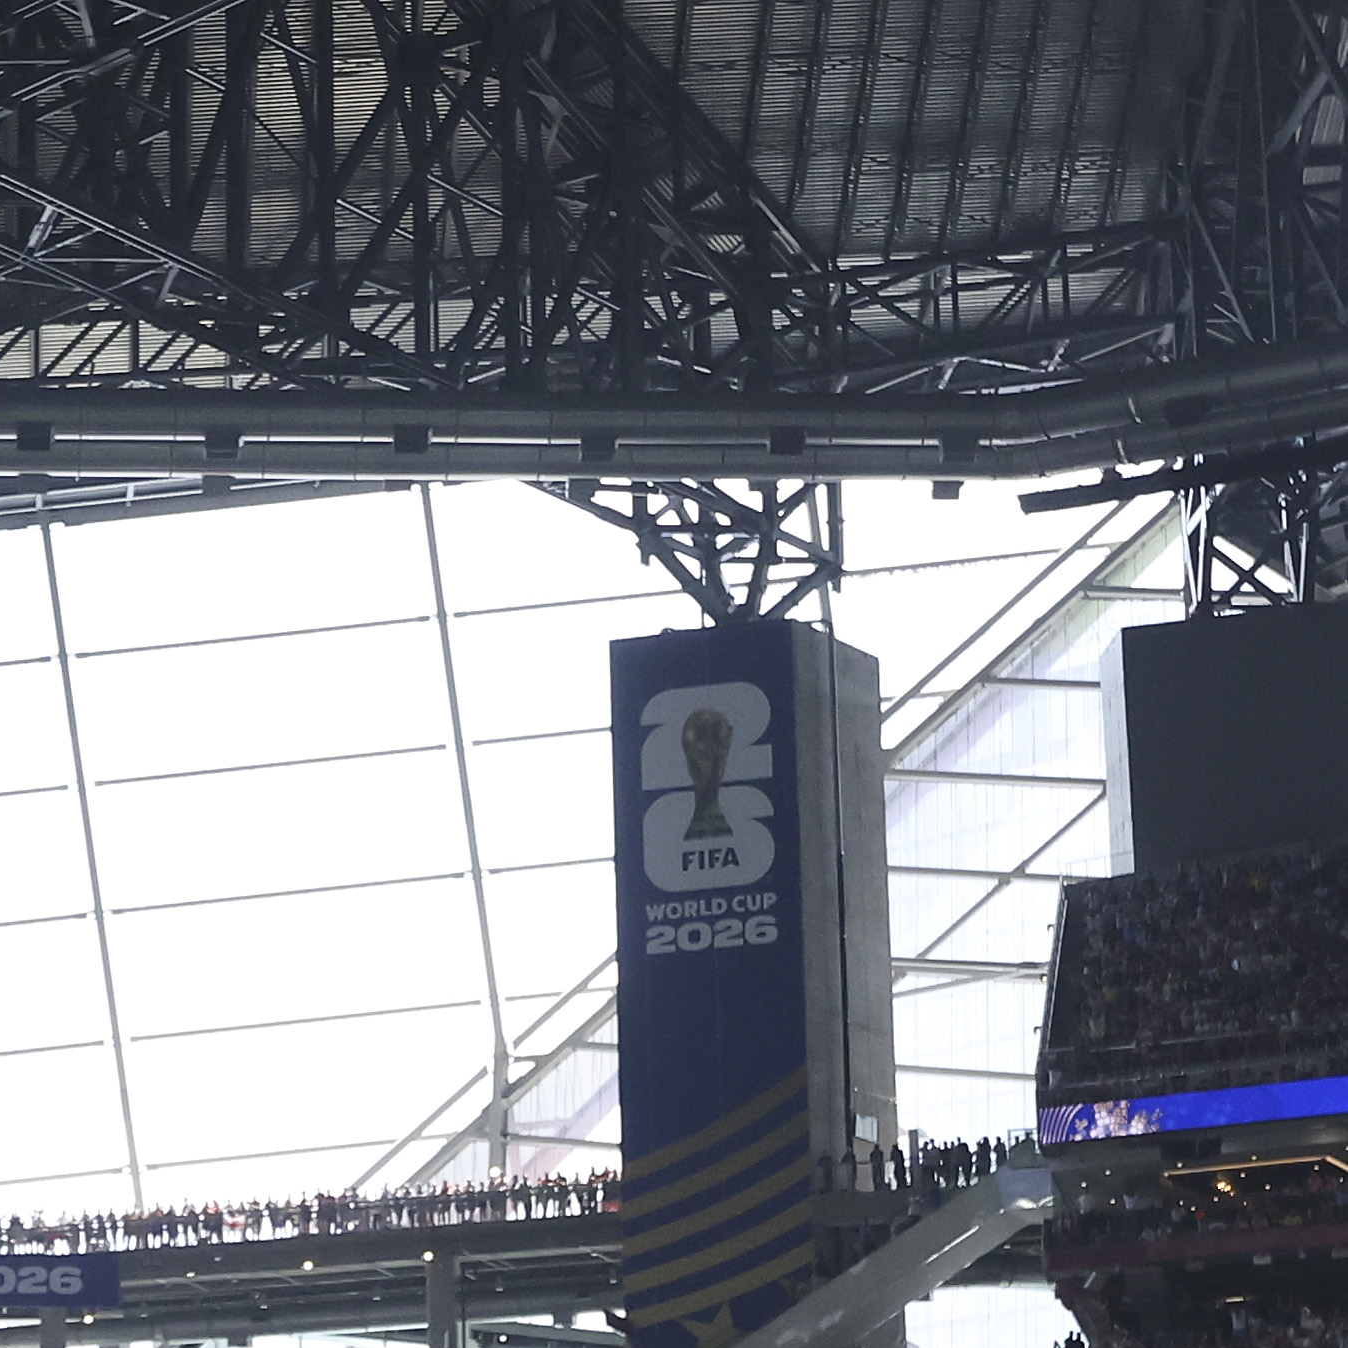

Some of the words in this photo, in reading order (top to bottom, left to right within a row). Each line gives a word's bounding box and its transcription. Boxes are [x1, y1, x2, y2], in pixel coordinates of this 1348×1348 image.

[682, 848, 739, 871] FIFA
[646, 898, 727, 922] WORLD
[733, 893, 777, 911] CUP
[646, 915, 778, 955] 2026
